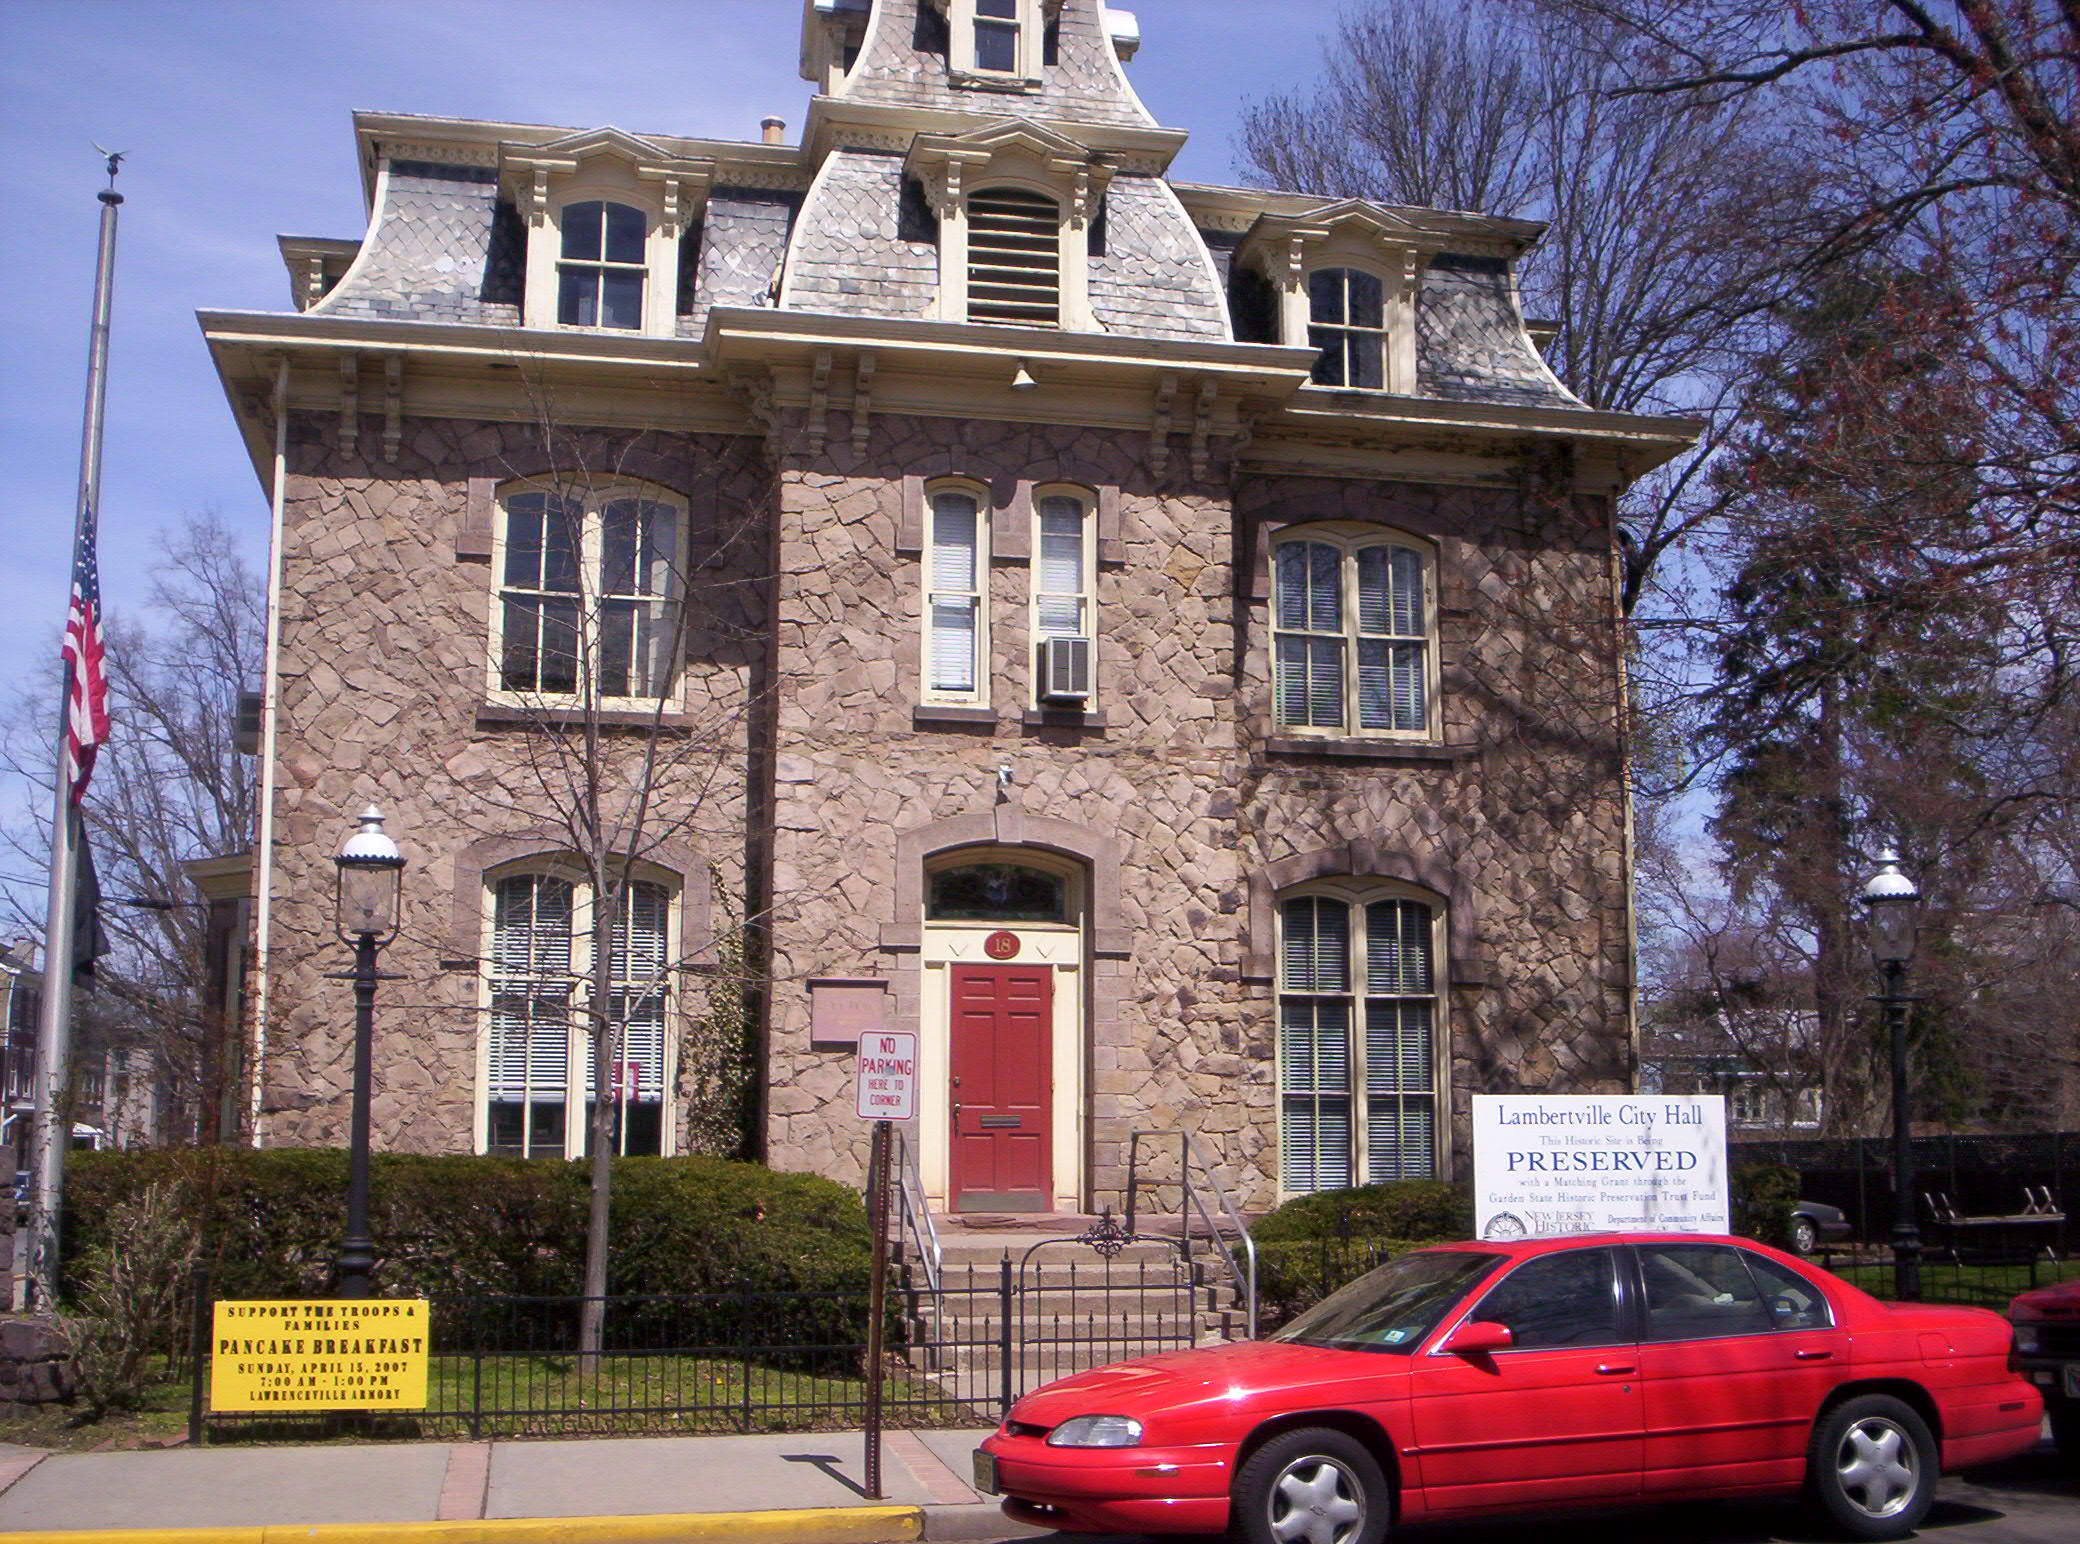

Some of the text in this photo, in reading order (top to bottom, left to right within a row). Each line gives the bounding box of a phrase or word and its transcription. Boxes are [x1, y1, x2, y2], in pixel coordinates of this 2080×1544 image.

[995, 938, 1011, 952] 18
[880, 1038, 896, 1054] NO
[868, 1079, 904, 1091] HERE TO
[870, 1094, 902, 1106] CORNER
[1498, 1104, 1702, 1127] Lambertville City Hall
[1539, 1136, 1664, 1147] This Historic Site is Being
[1507, 1151, 1698, 1172] PRESERVED
[1520, 1177, 1540, 1187] with
[1554, 1177, 1598, 1188] Matching
[1601, 1177, 1629, 1186] Grant
[1633, 1176, 1669, 1188] through
[1672, 1176, 1687, 1186] the
[1488, 1190, 1716, 1204] Garden State Historic Preservation Trust Fund
[1555, 1210, 1594, 1222] JERSEY
[1608, 1214, 1648, 1225] Department
[1658, 1214, 1698, 1226] Community
[1700, 1214, 1724, 1223] Affairs
[1534, 1220, 1594, 1233] HISTORIC
[228, 1306, 415, 1318] SUPPORT THE TROOPS &
[284, 1320, 360, 1331] FAMILIES
[220, 1338, 423, 1355] PANCAKE BREAKFAST
[300, 1362, 343, 1373] APRIL
[350, 1362, 370, 1374] 15,
[374, 1362, 408, 1372] 2007
[260, 1377, 292, 1387] 7:00
[297, 1376, 317, 1387] AM
[334, 1376, 364, 1386] 1:00
[370, 1376, 388, 1386] PM
[250, 1389, 400, 1401] LAWRENCEVILLE ARMORY
